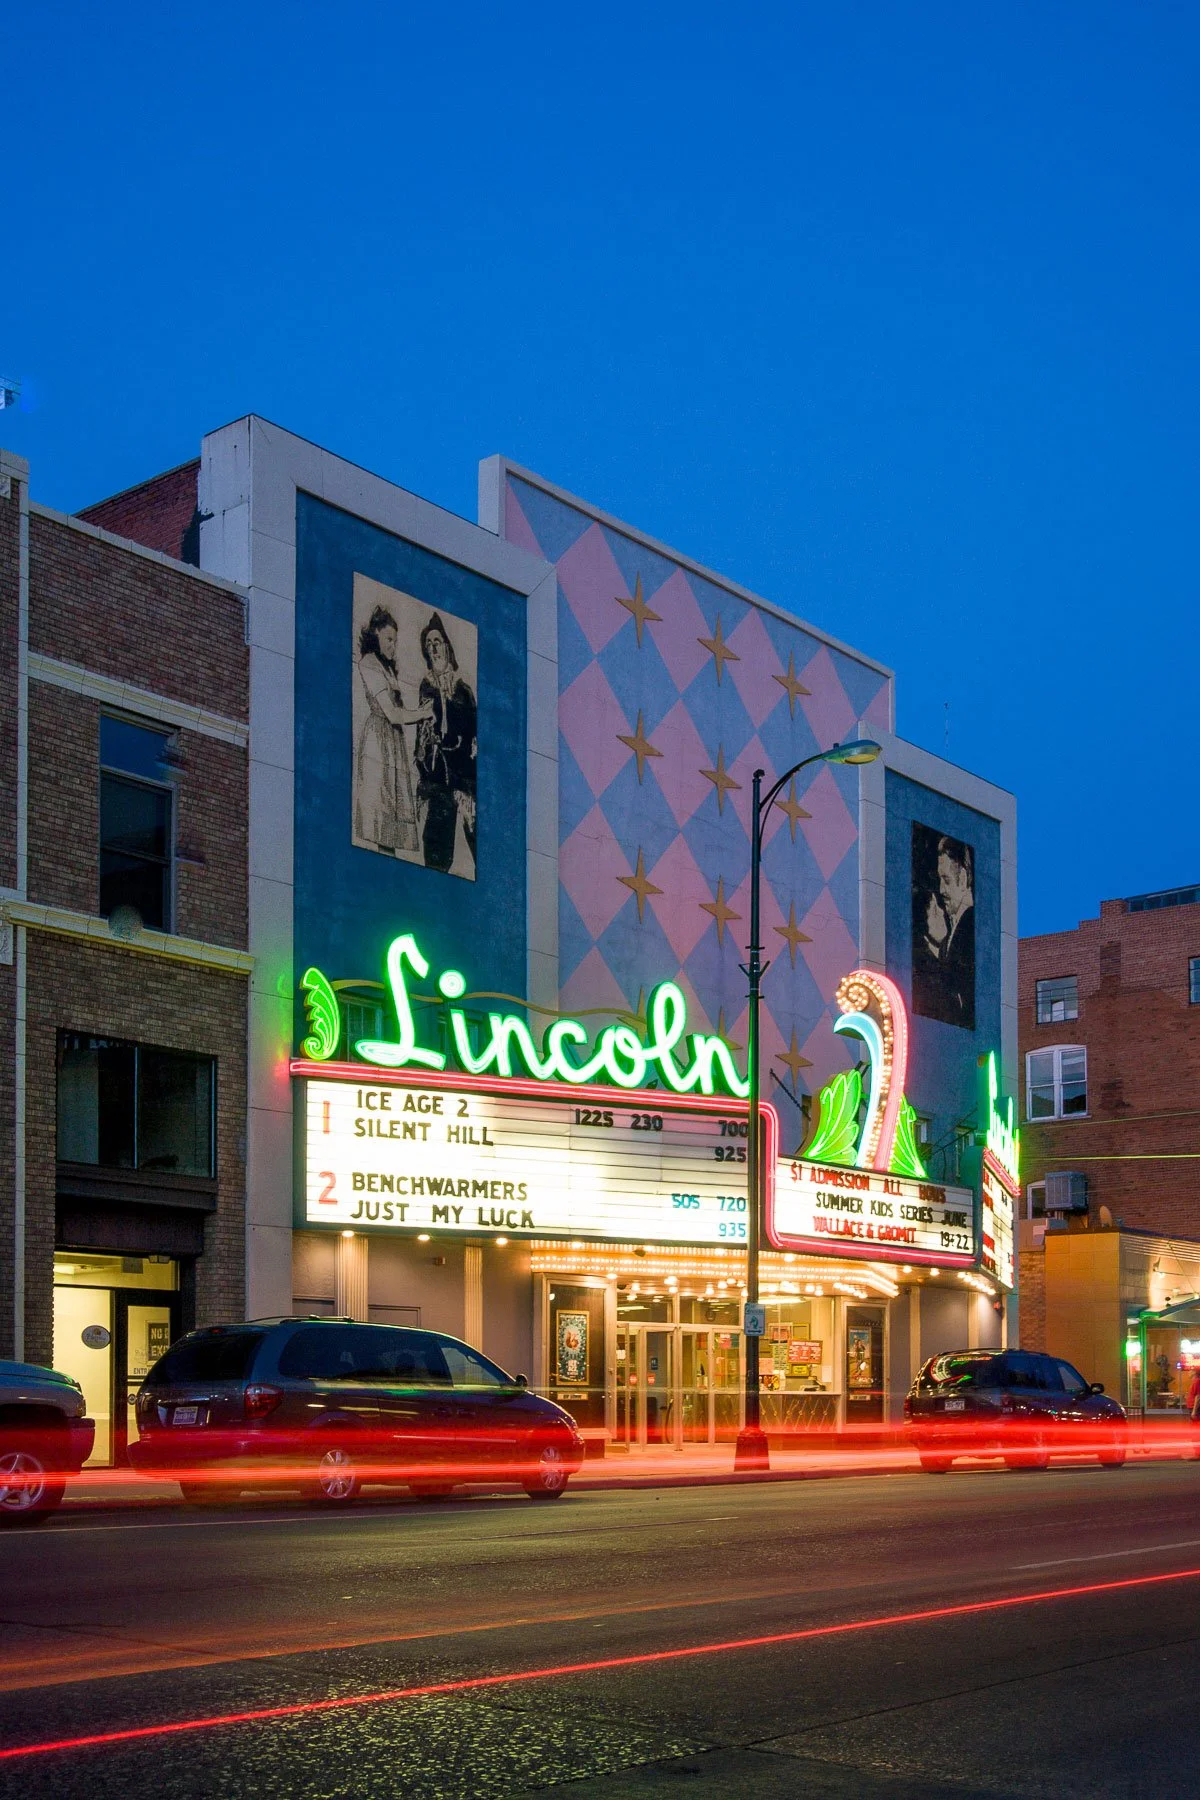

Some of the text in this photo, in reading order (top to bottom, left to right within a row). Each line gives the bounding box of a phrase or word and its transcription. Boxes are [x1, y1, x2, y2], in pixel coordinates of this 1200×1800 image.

[355, 933, 750, 1098] Lincoln
[357, 1089, 470, 1118] ICE AGE 2
[354, 1117, 494, 1147] SILENT HILL
[575, 1108, 748, 1138] 1225 230 700
[714, 1145, 747, 1163] 925
[318, 1170, 338, 1205] 2
[352, 1171, 528, 1201] BENCHWARMERS
[810, 1165, 870, 1192] ADMISSION
[883, 1177, 903, 1197] ALL
[350, 1200, 535, 1229] JUST MY LUCK
[672, 1193, 746, 1212] 505 720
[816, 1191, 967, 1229] SUMMER KIDS SERIES JUNE
[718, 1222, 747, 1238] 935
[812, 1215, 916, 1244] WALLACE & GROMIT
